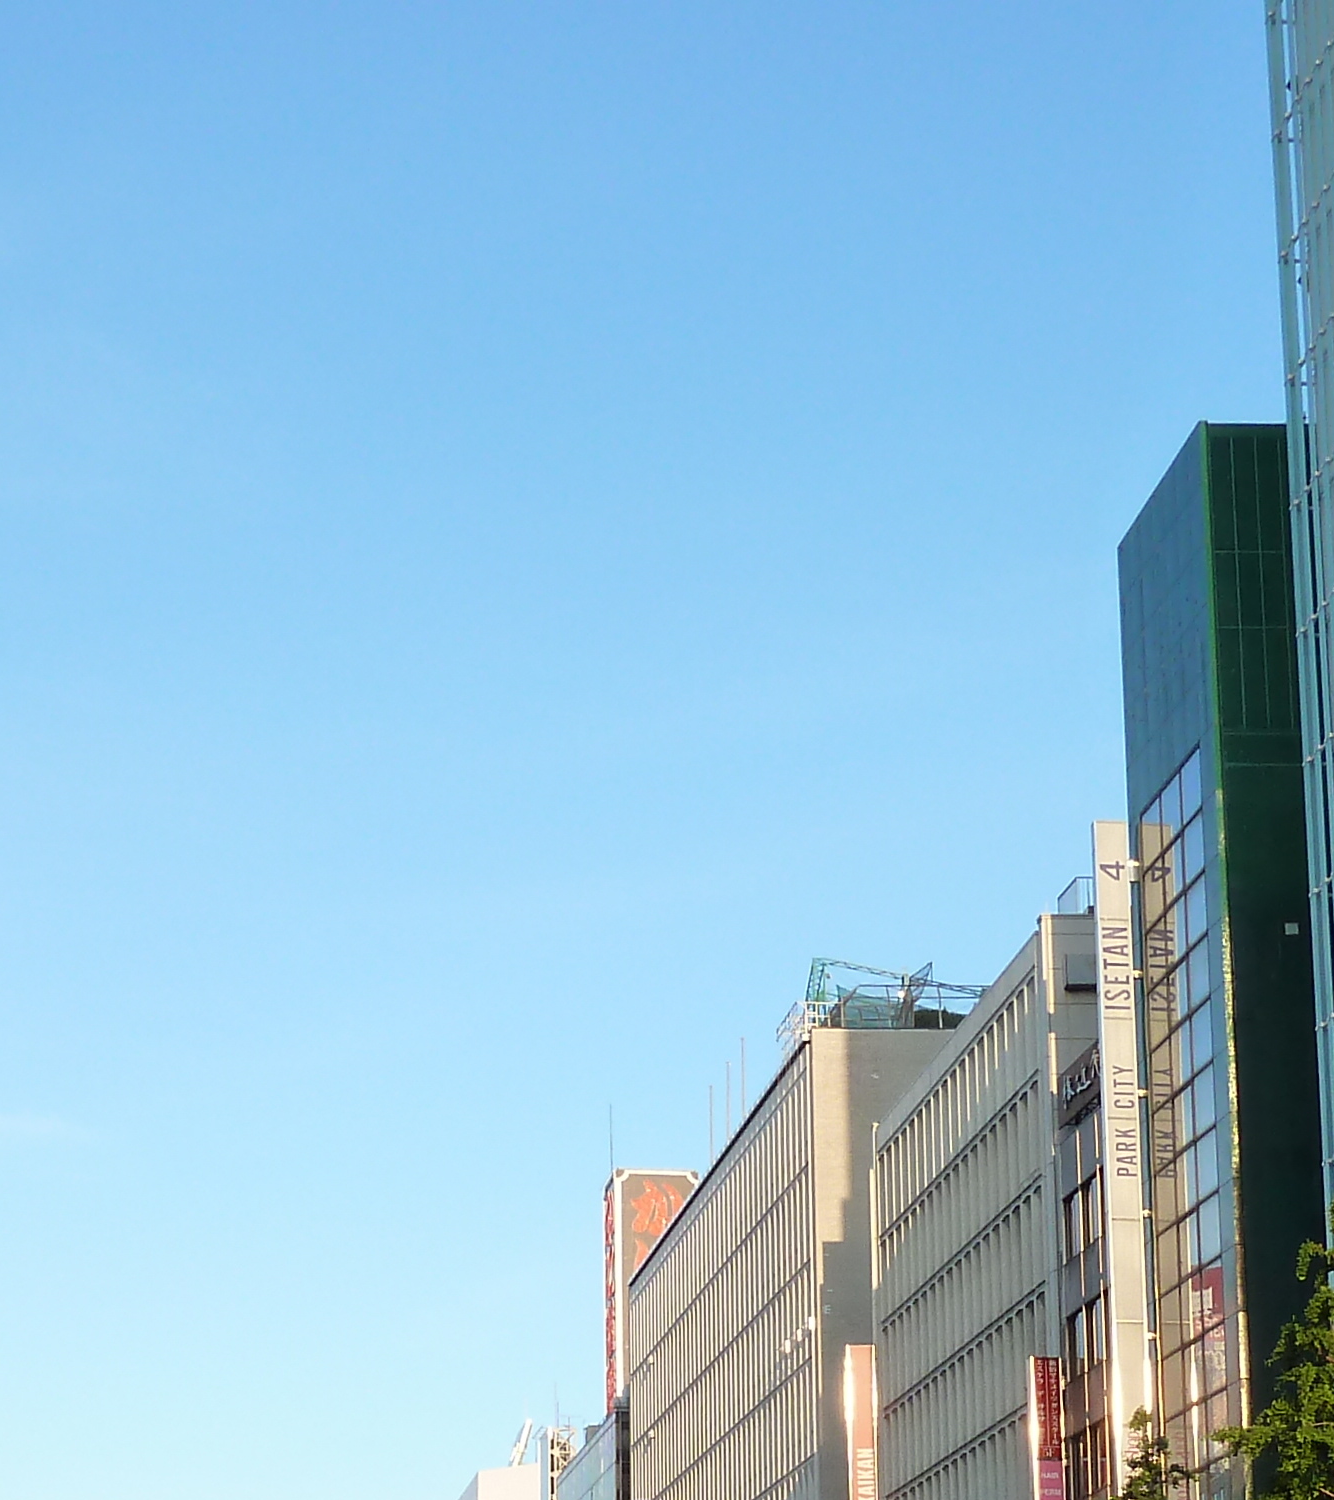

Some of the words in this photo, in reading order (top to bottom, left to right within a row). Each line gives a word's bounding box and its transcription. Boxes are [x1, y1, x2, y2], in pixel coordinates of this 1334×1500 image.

[1100, 861, 1125, 881] 4
[1101, 927, 1131, 1010] ISETAN
[1112, 1065, 1135, 1109] CITY
[1115, 1128, 1138, 1177] PARK
